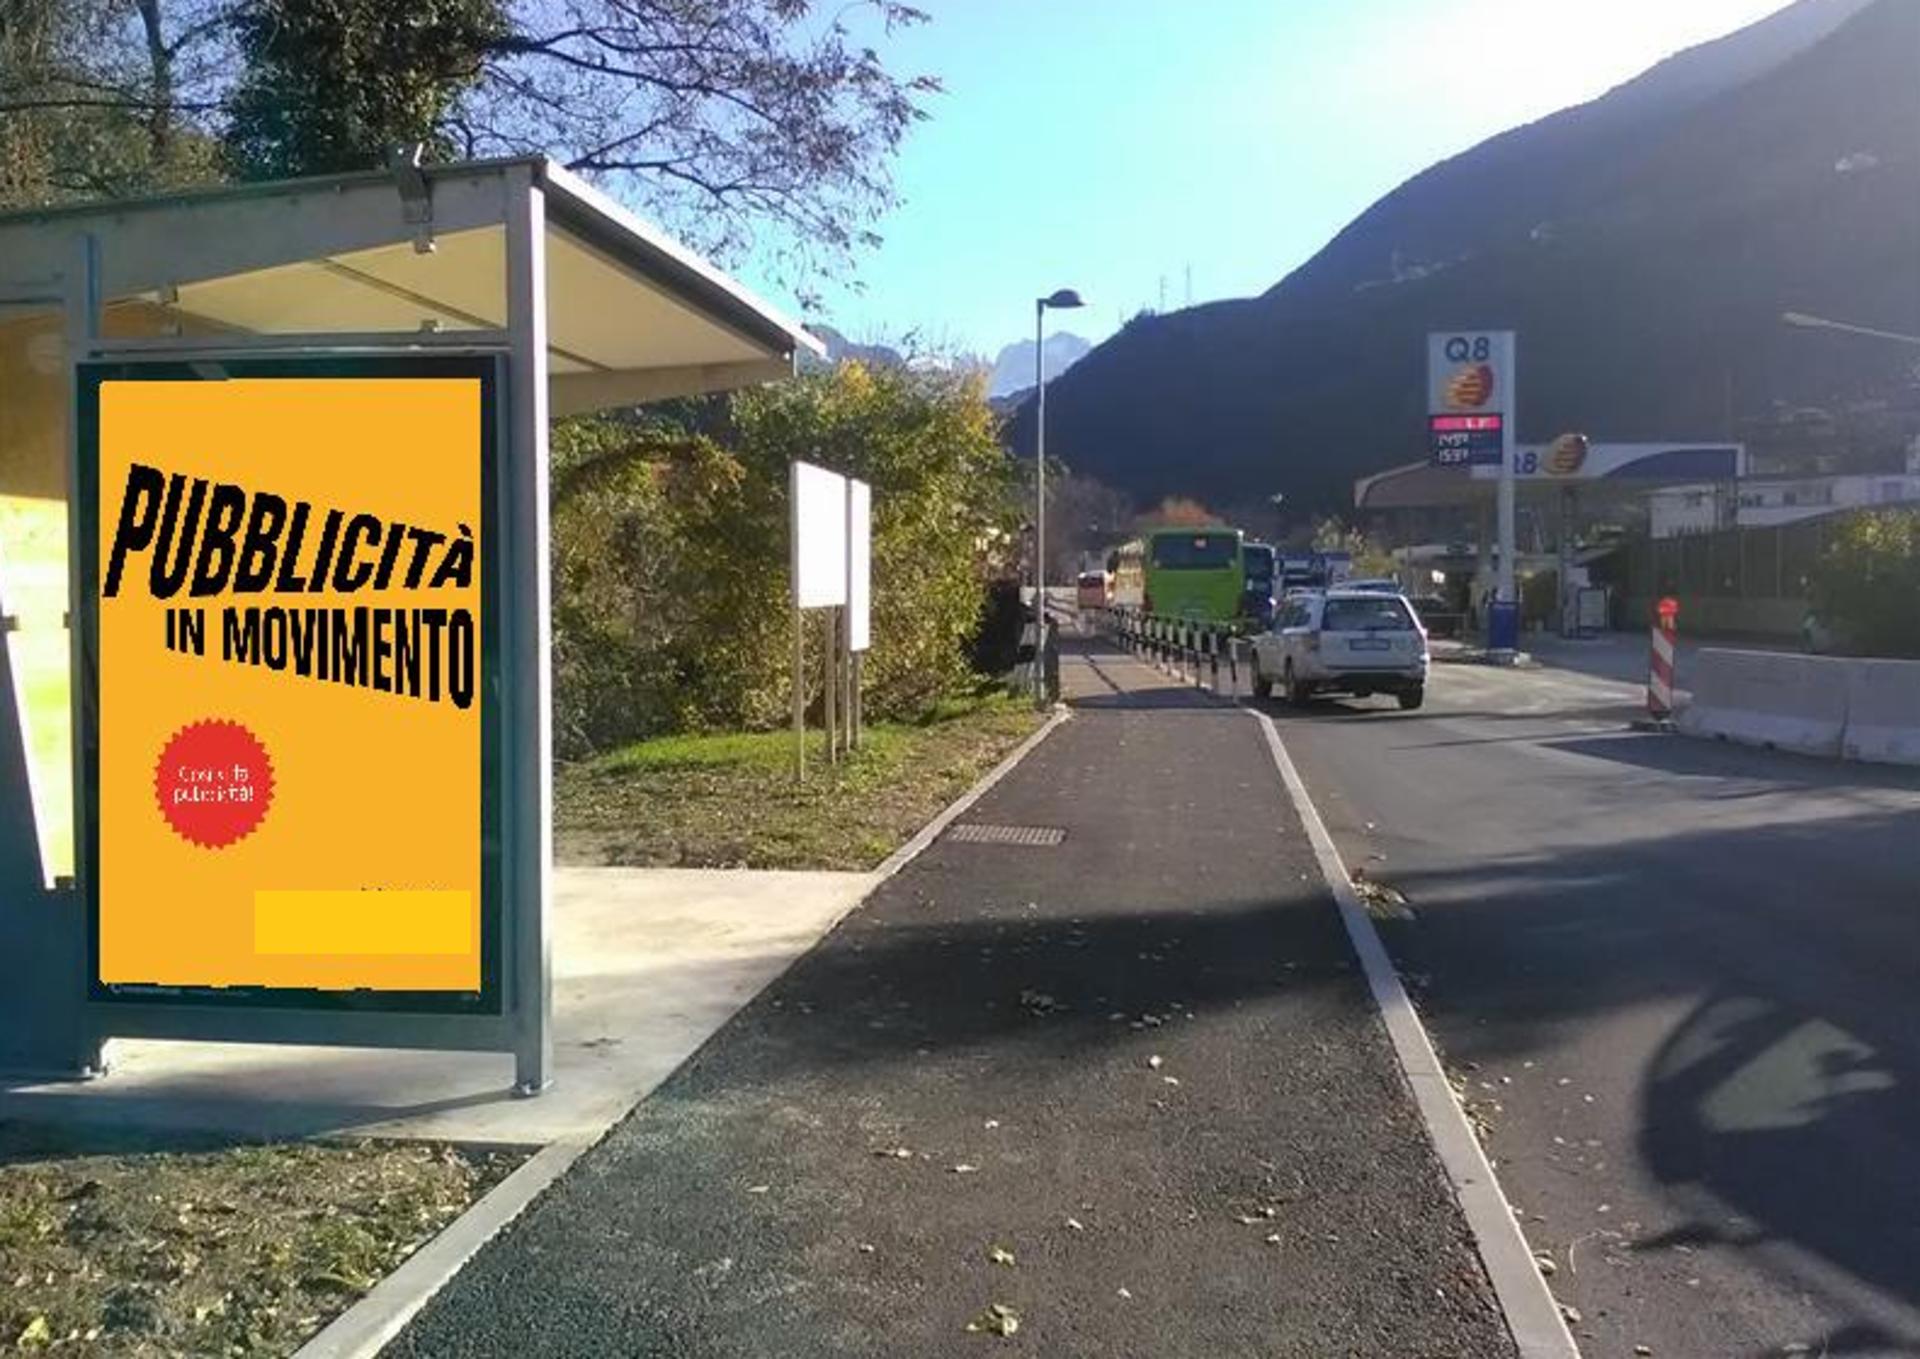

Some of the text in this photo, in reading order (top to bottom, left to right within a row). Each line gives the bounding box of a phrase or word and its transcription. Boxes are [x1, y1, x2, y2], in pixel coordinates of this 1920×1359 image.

[1444, 336, 1489, 363] Q8
[102, 463, 474, 599] PUBBLICITÀ
[166, 607, 474, 709] IN MOVIMENTO
